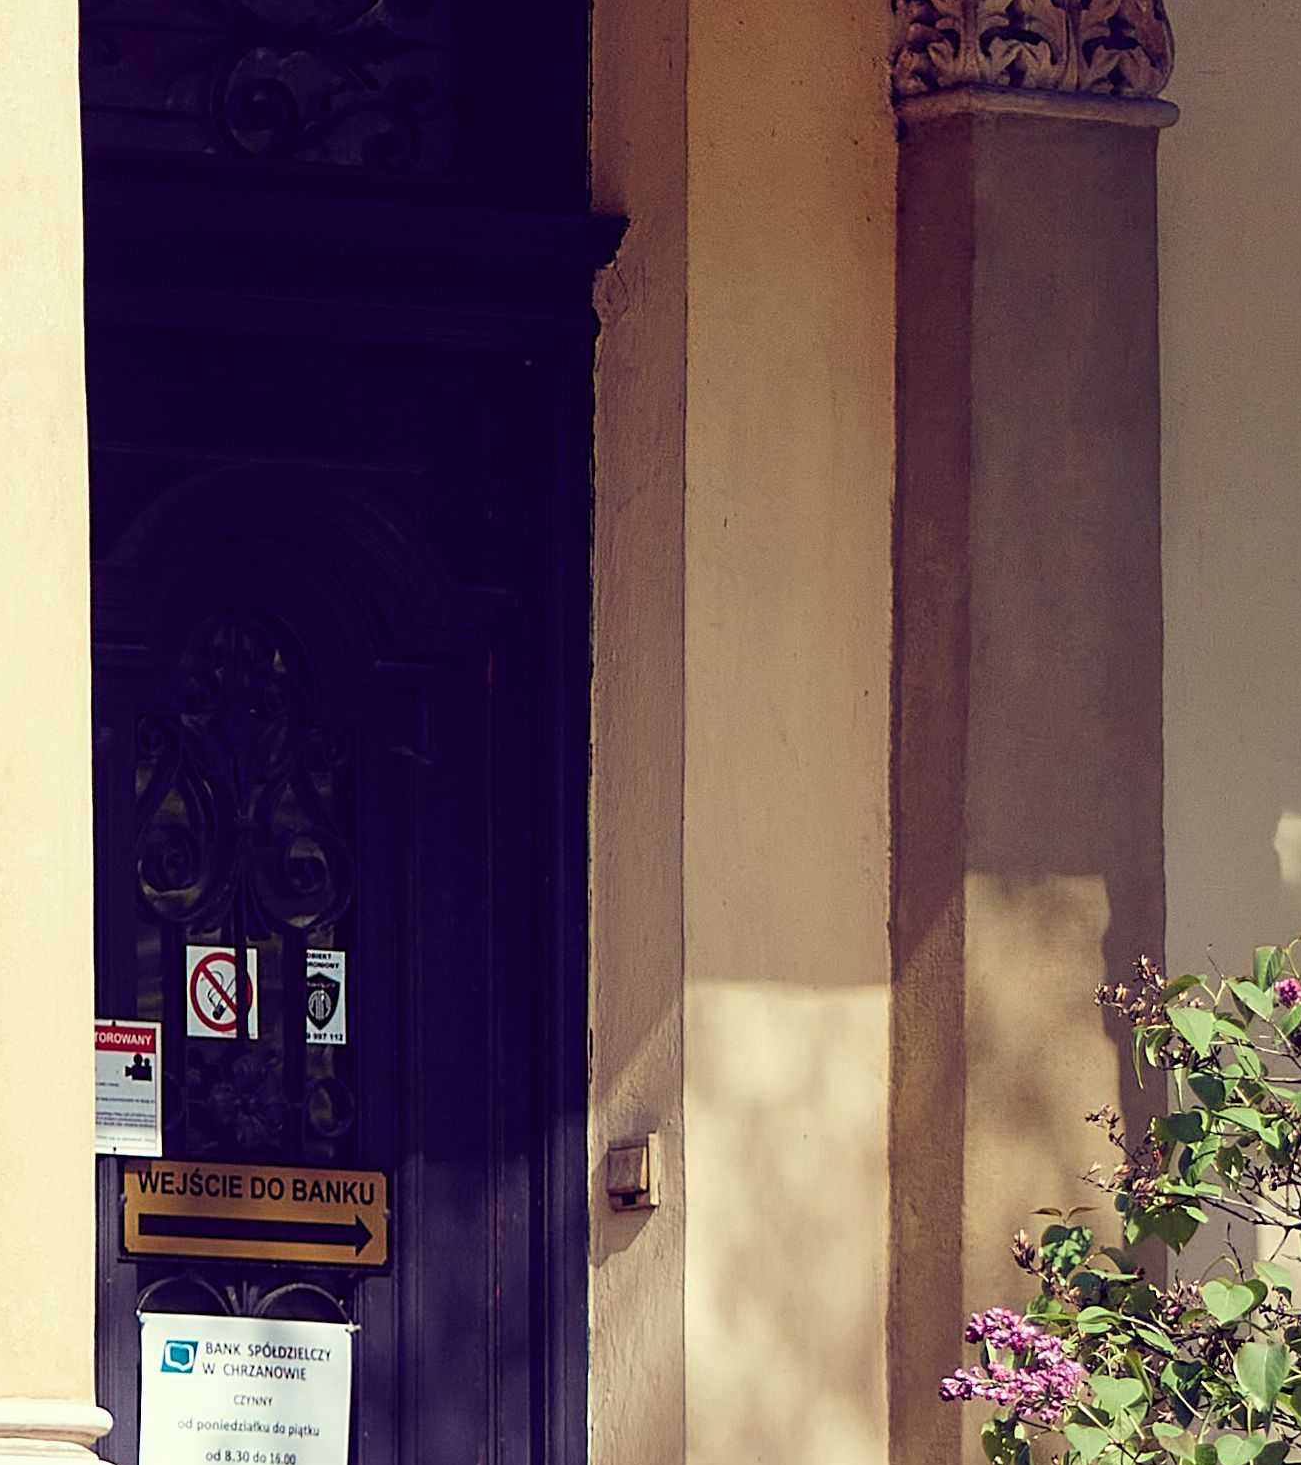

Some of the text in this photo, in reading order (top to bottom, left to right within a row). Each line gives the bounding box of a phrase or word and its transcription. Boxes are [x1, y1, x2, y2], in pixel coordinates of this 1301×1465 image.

[138, 1168, 375, 1205] WEJŚCIE DO BANKU
[205, 1342, 331, 1362] BANK SPÓŁDZIELCZY
[202, 1363, 307, 1381] W CHRZANOWIE
[233, 1394, 273, 1407] CZYNNY
[178, 1418, 320, 1438] od poniedziałku do piątku
[206, 1449, 221, 1462] od
[225, 1450, 250, 1463] 8.30
[253, 1450, 267, 1464] do
